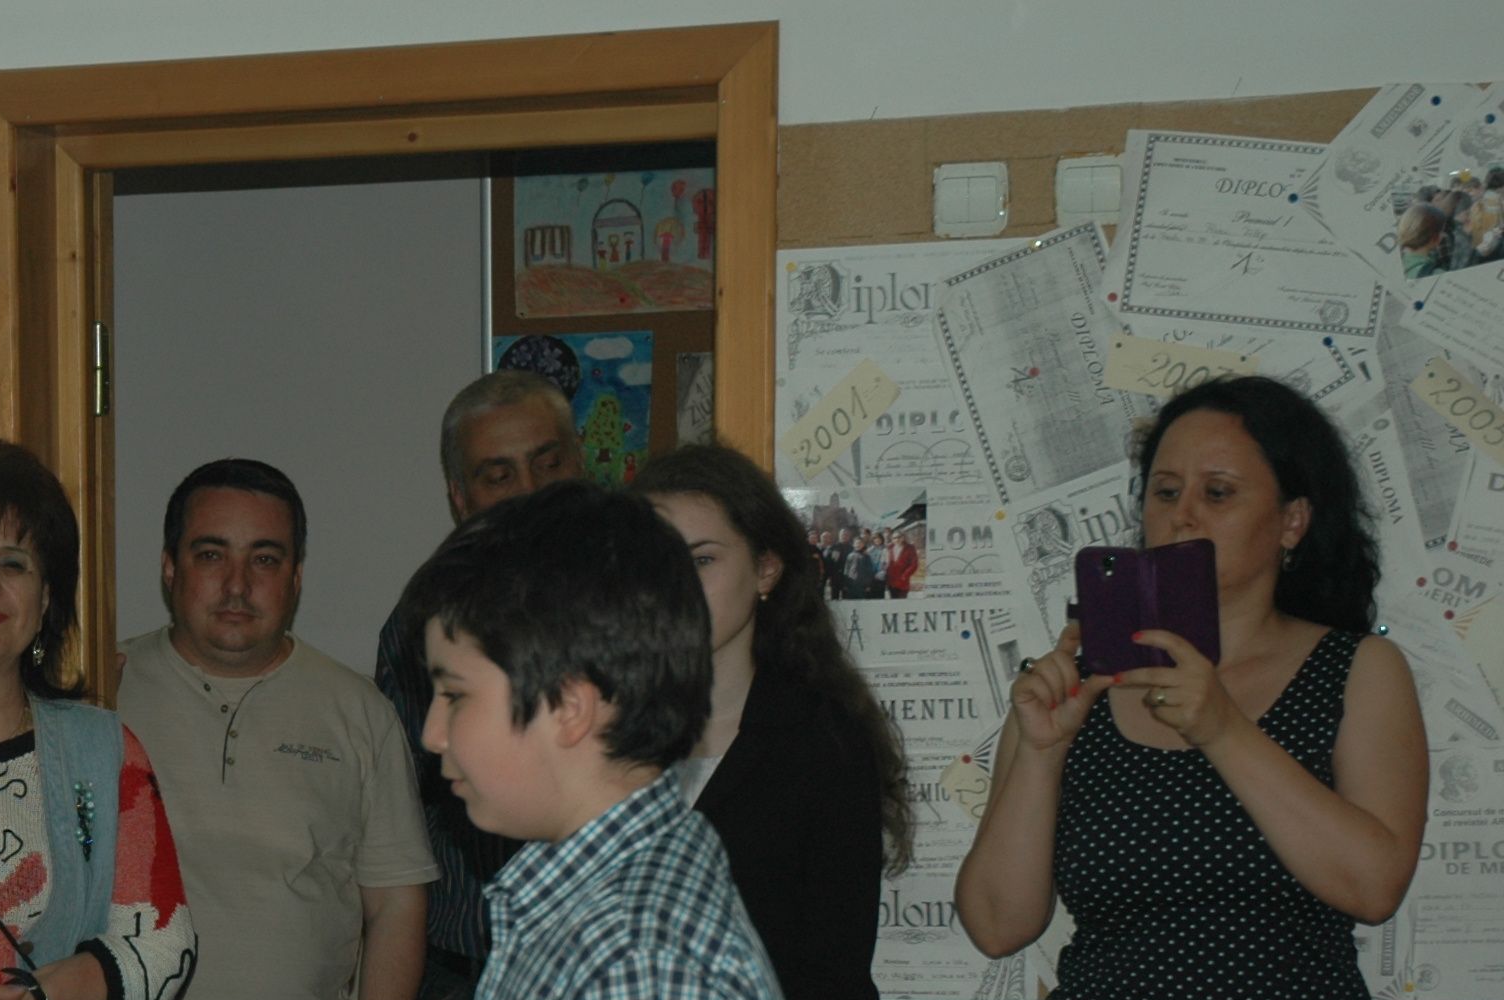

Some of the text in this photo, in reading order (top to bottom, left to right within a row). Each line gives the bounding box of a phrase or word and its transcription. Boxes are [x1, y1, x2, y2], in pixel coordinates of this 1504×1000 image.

[1137, 352, 1235, 390] 200
[800, 386, 868, 468] 2001
[1368, 450, 1406, 525] DIPLOMA
[1446, 861, 1471, 876] DE
